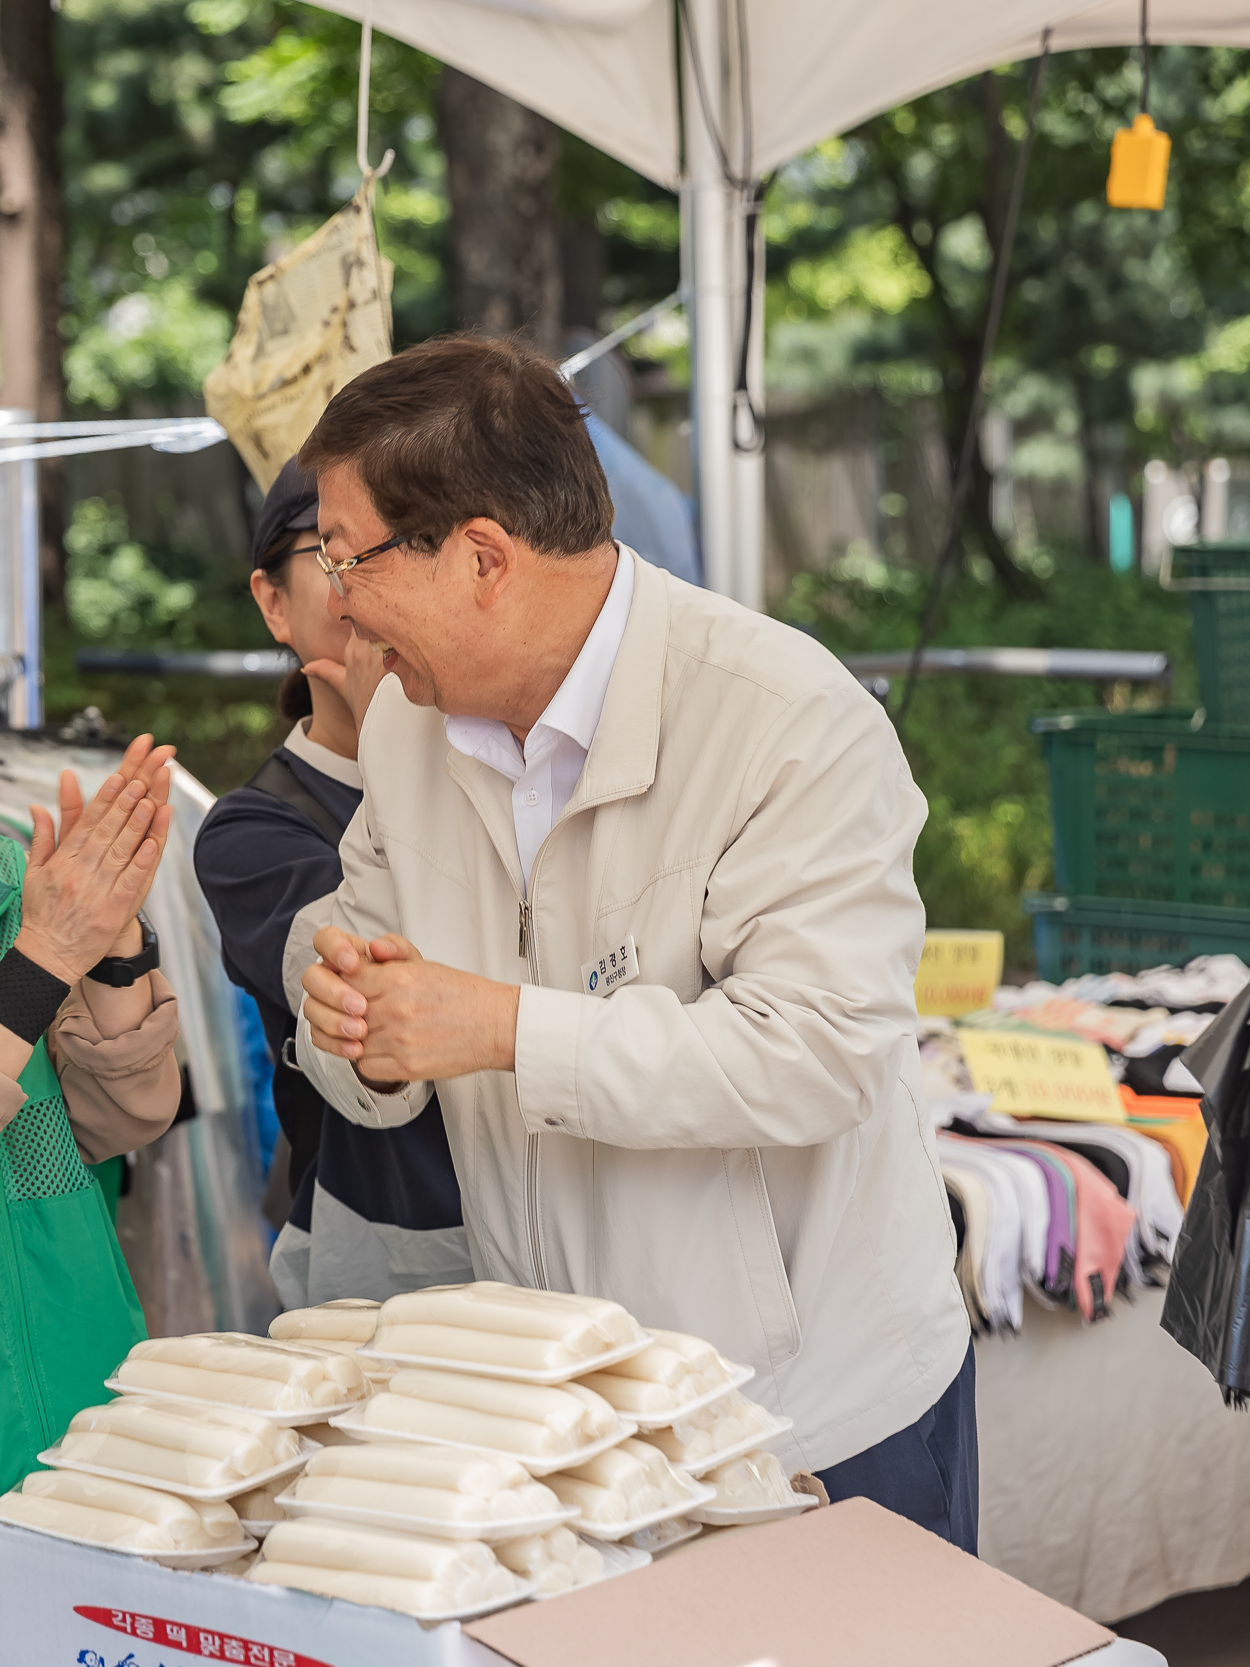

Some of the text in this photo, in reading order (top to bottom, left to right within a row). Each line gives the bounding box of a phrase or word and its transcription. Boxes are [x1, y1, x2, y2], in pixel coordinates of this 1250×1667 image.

[111, 1609, 297, 1667] 각종 떡 맞춤전문
